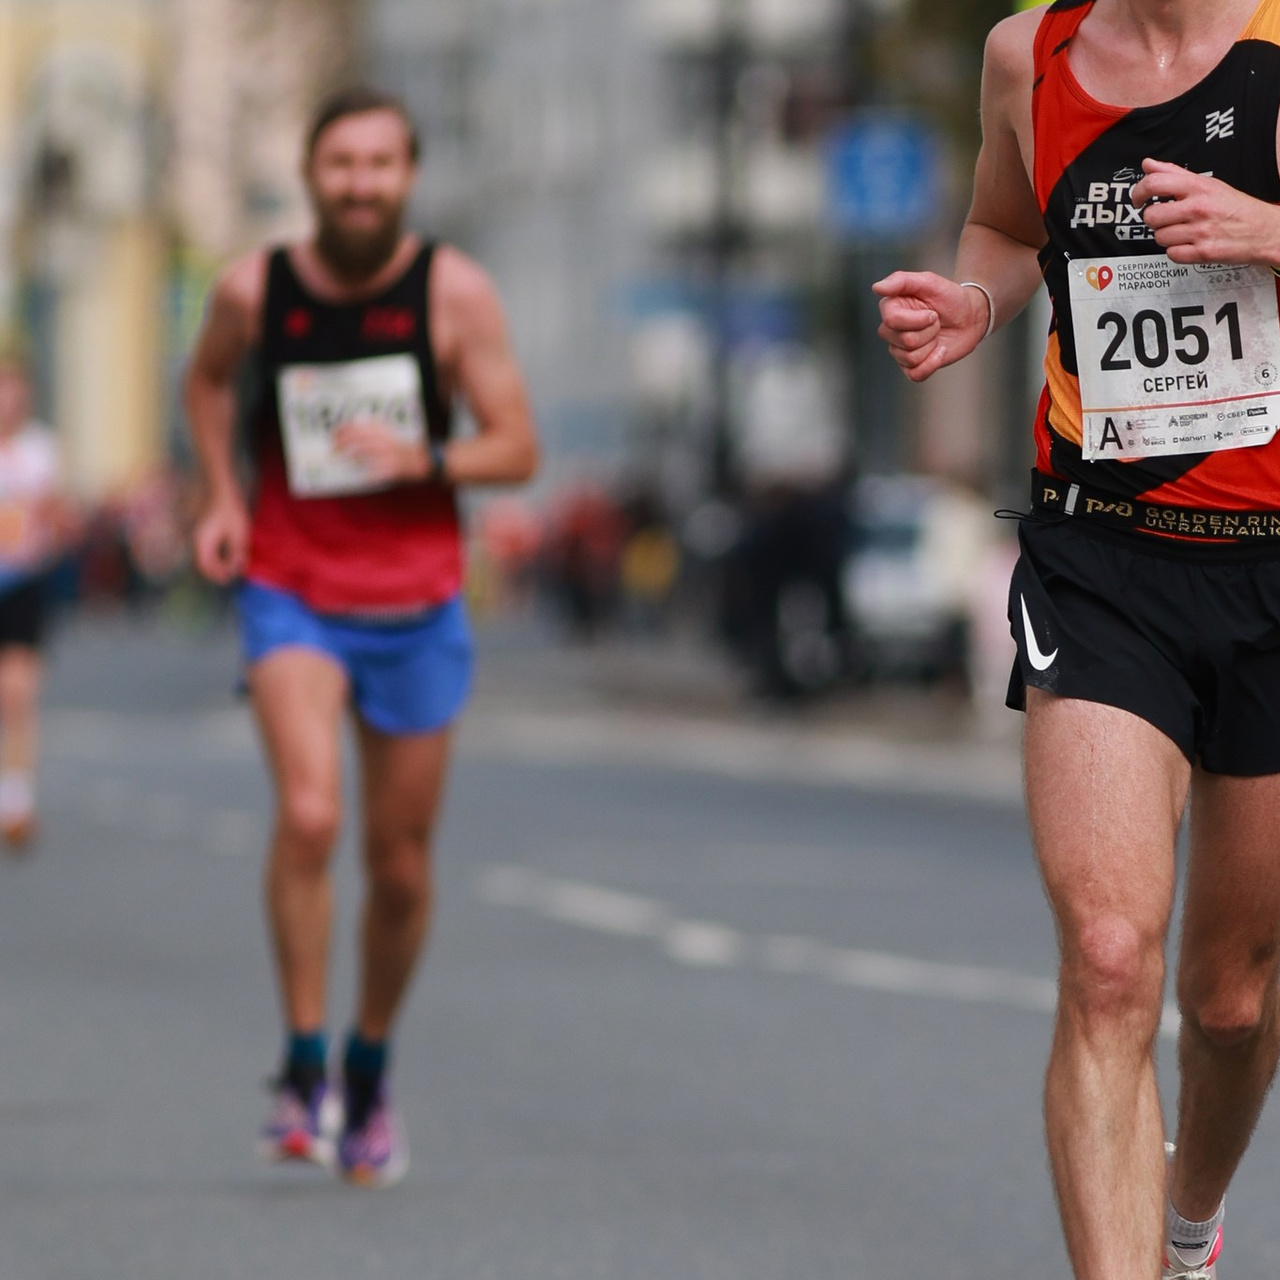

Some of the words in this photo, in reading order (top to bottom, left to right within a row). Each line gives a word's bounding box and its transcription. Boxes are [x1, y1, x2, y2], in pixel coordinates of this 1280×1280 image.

[1117, 261, 1168, 271] СБЕРПРАЙМ
[1118, 267, 1189, 281] МОСКОВСКИЙ
[1119, 280, 1170, 291] МАРАФОН
[1097, 302, 1243, 371] 2051
[1261, 369, 1270, 378] 6
[1143, 371, 1208, 393] СЕРГЕЙ
[1146, 507, 1239, 526] GOLDEN
[1146, 517, 1205, 534] ULTRA
[1210, 525, 1266, 536] TRAIL
